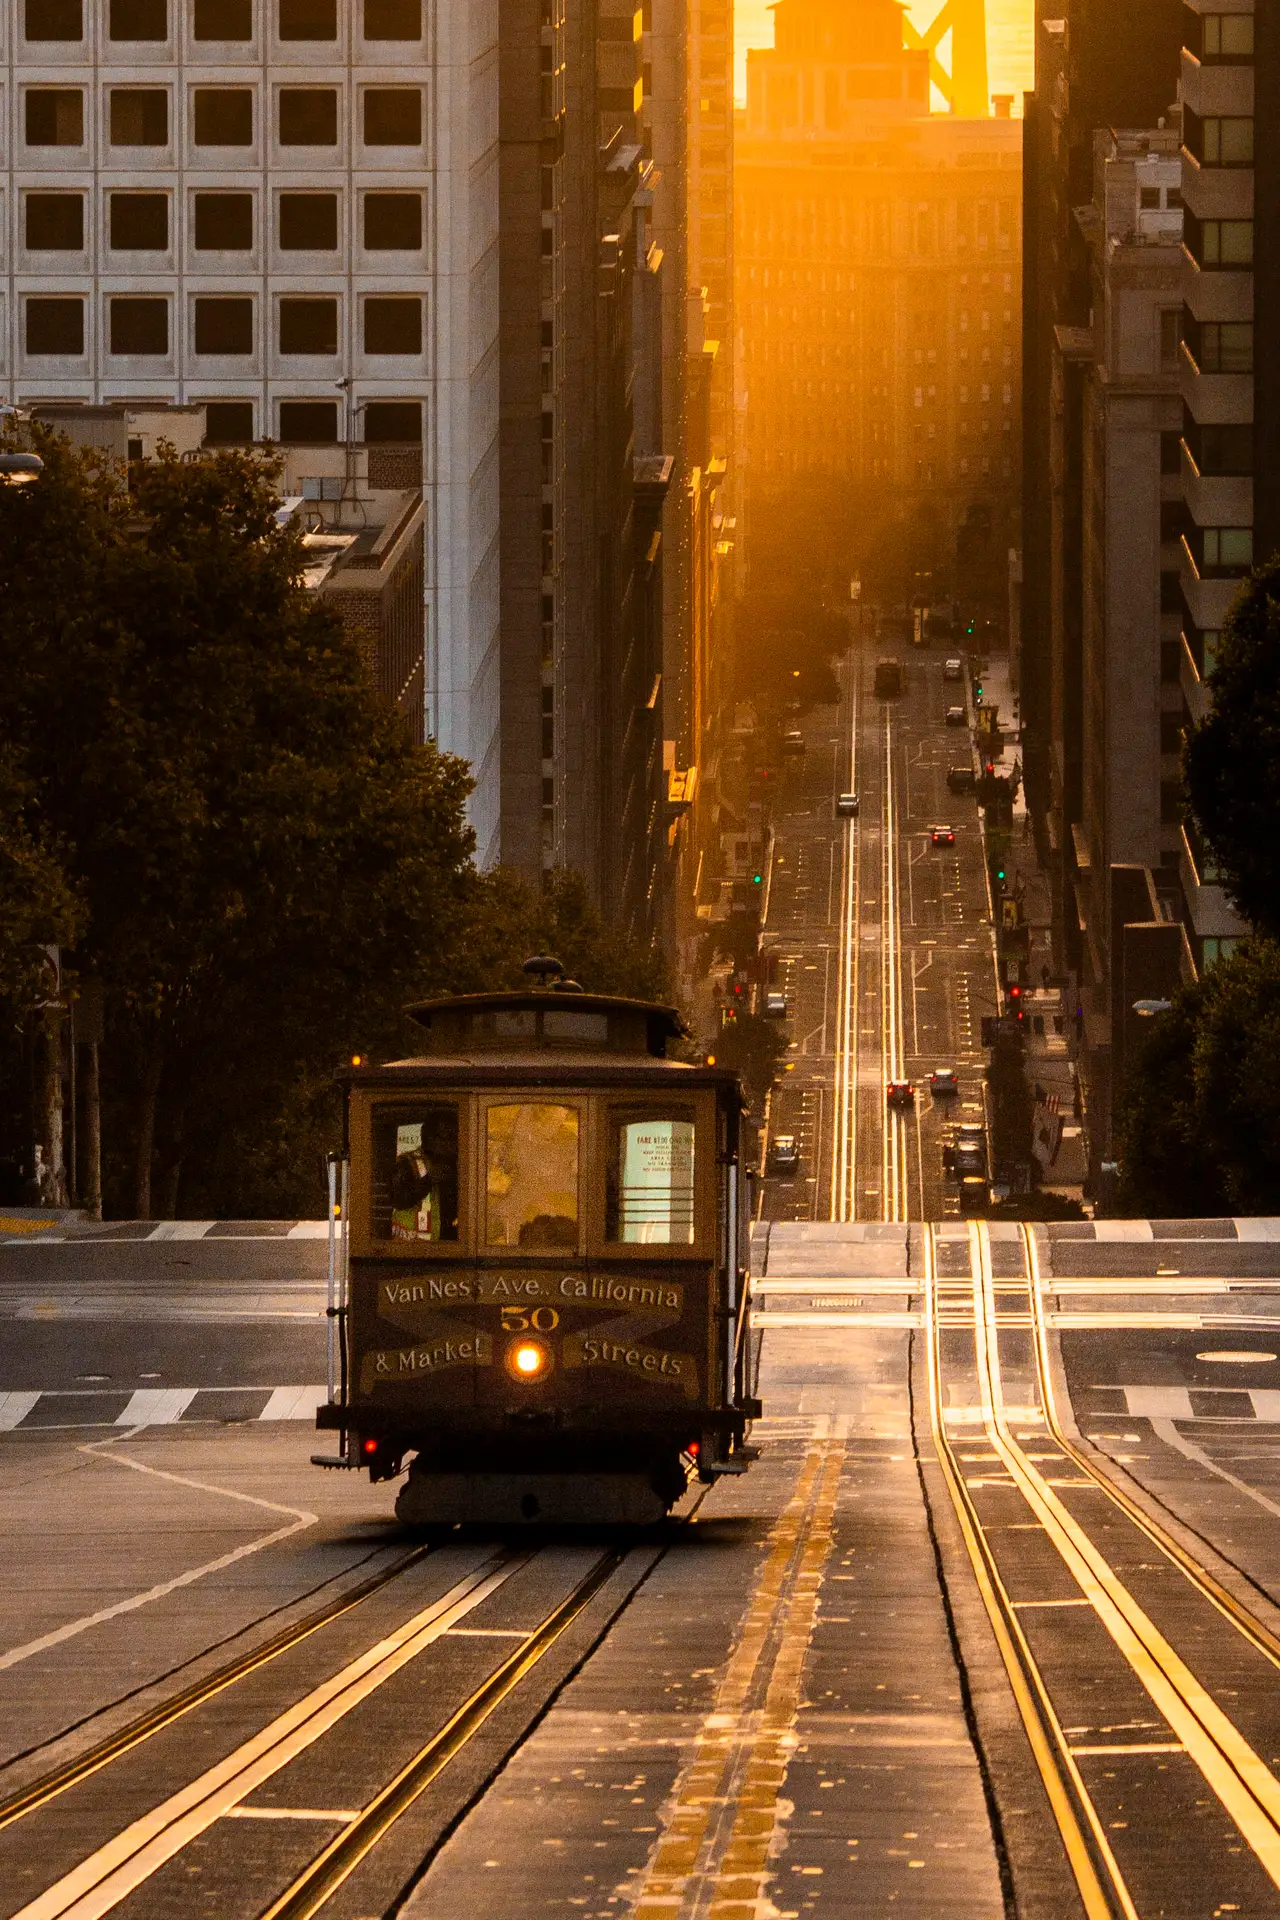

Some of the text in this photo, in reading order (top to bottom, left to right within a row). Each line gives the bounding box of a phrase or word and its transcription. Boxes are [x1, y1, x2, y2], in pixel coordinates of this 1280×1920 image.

[384, 1283, 424, 1304] Van
[560, 1276, 679, 1309] California
[501, 1306, 559, 1332] 50
[376, 1337, 683, 1376] & Market Streets
